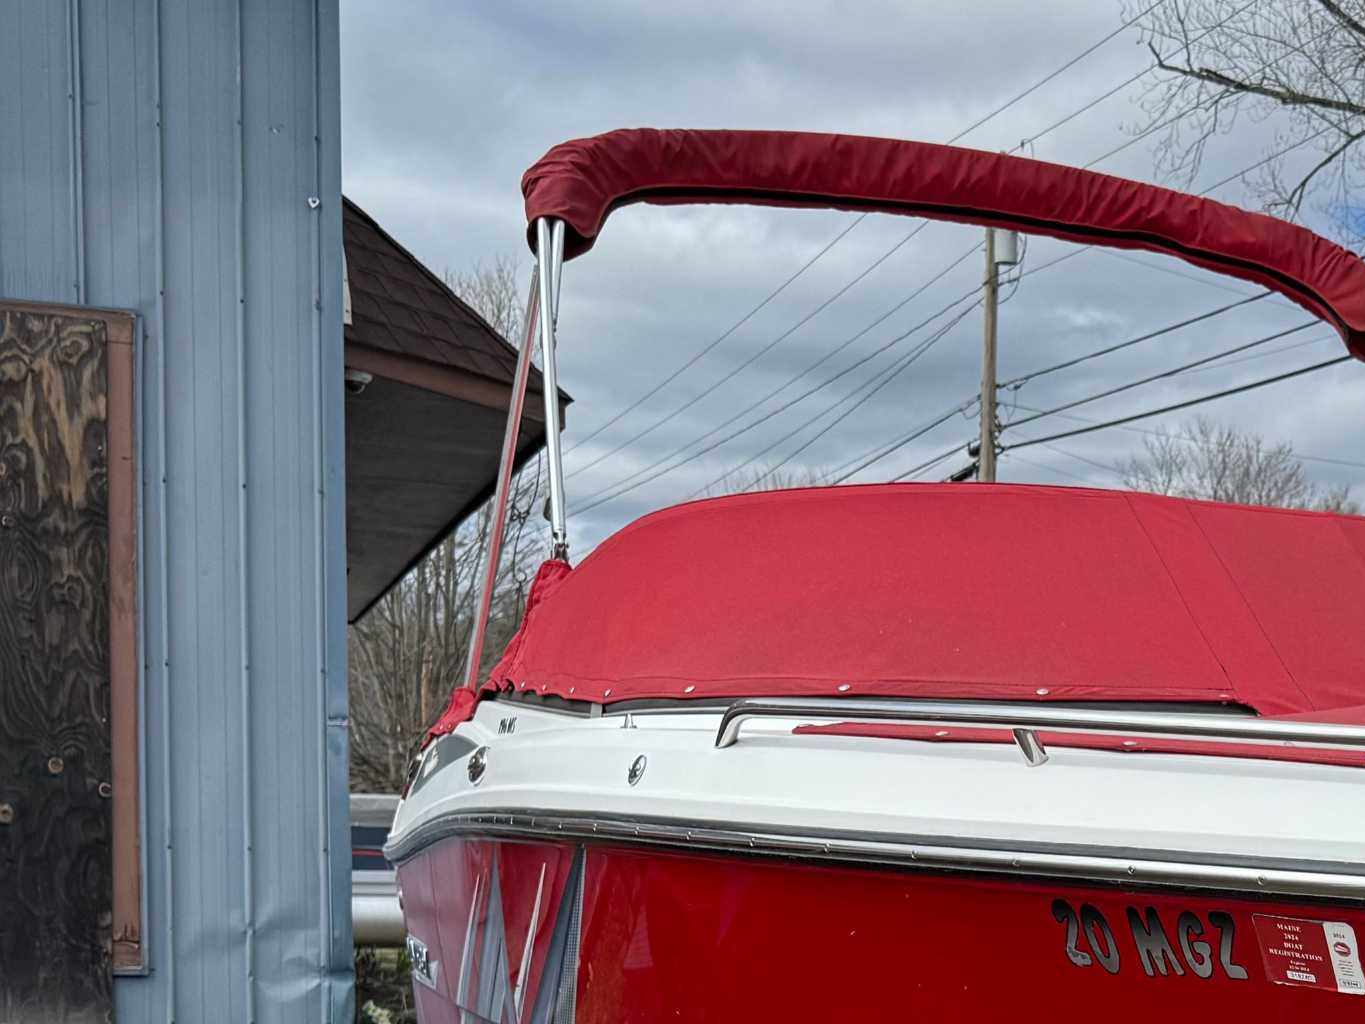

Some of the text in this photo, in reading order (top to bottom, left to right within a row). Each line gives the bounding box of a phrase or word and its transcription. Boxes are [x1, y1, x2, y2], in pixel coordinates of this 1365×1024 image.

[1277, 924, 1302, 932] MAINE
[1050, 896, 1120, 975] 20
[1283, 942, 1303, 950] BOAT
[1269, 948, 1323, 961] REGISTRATION
